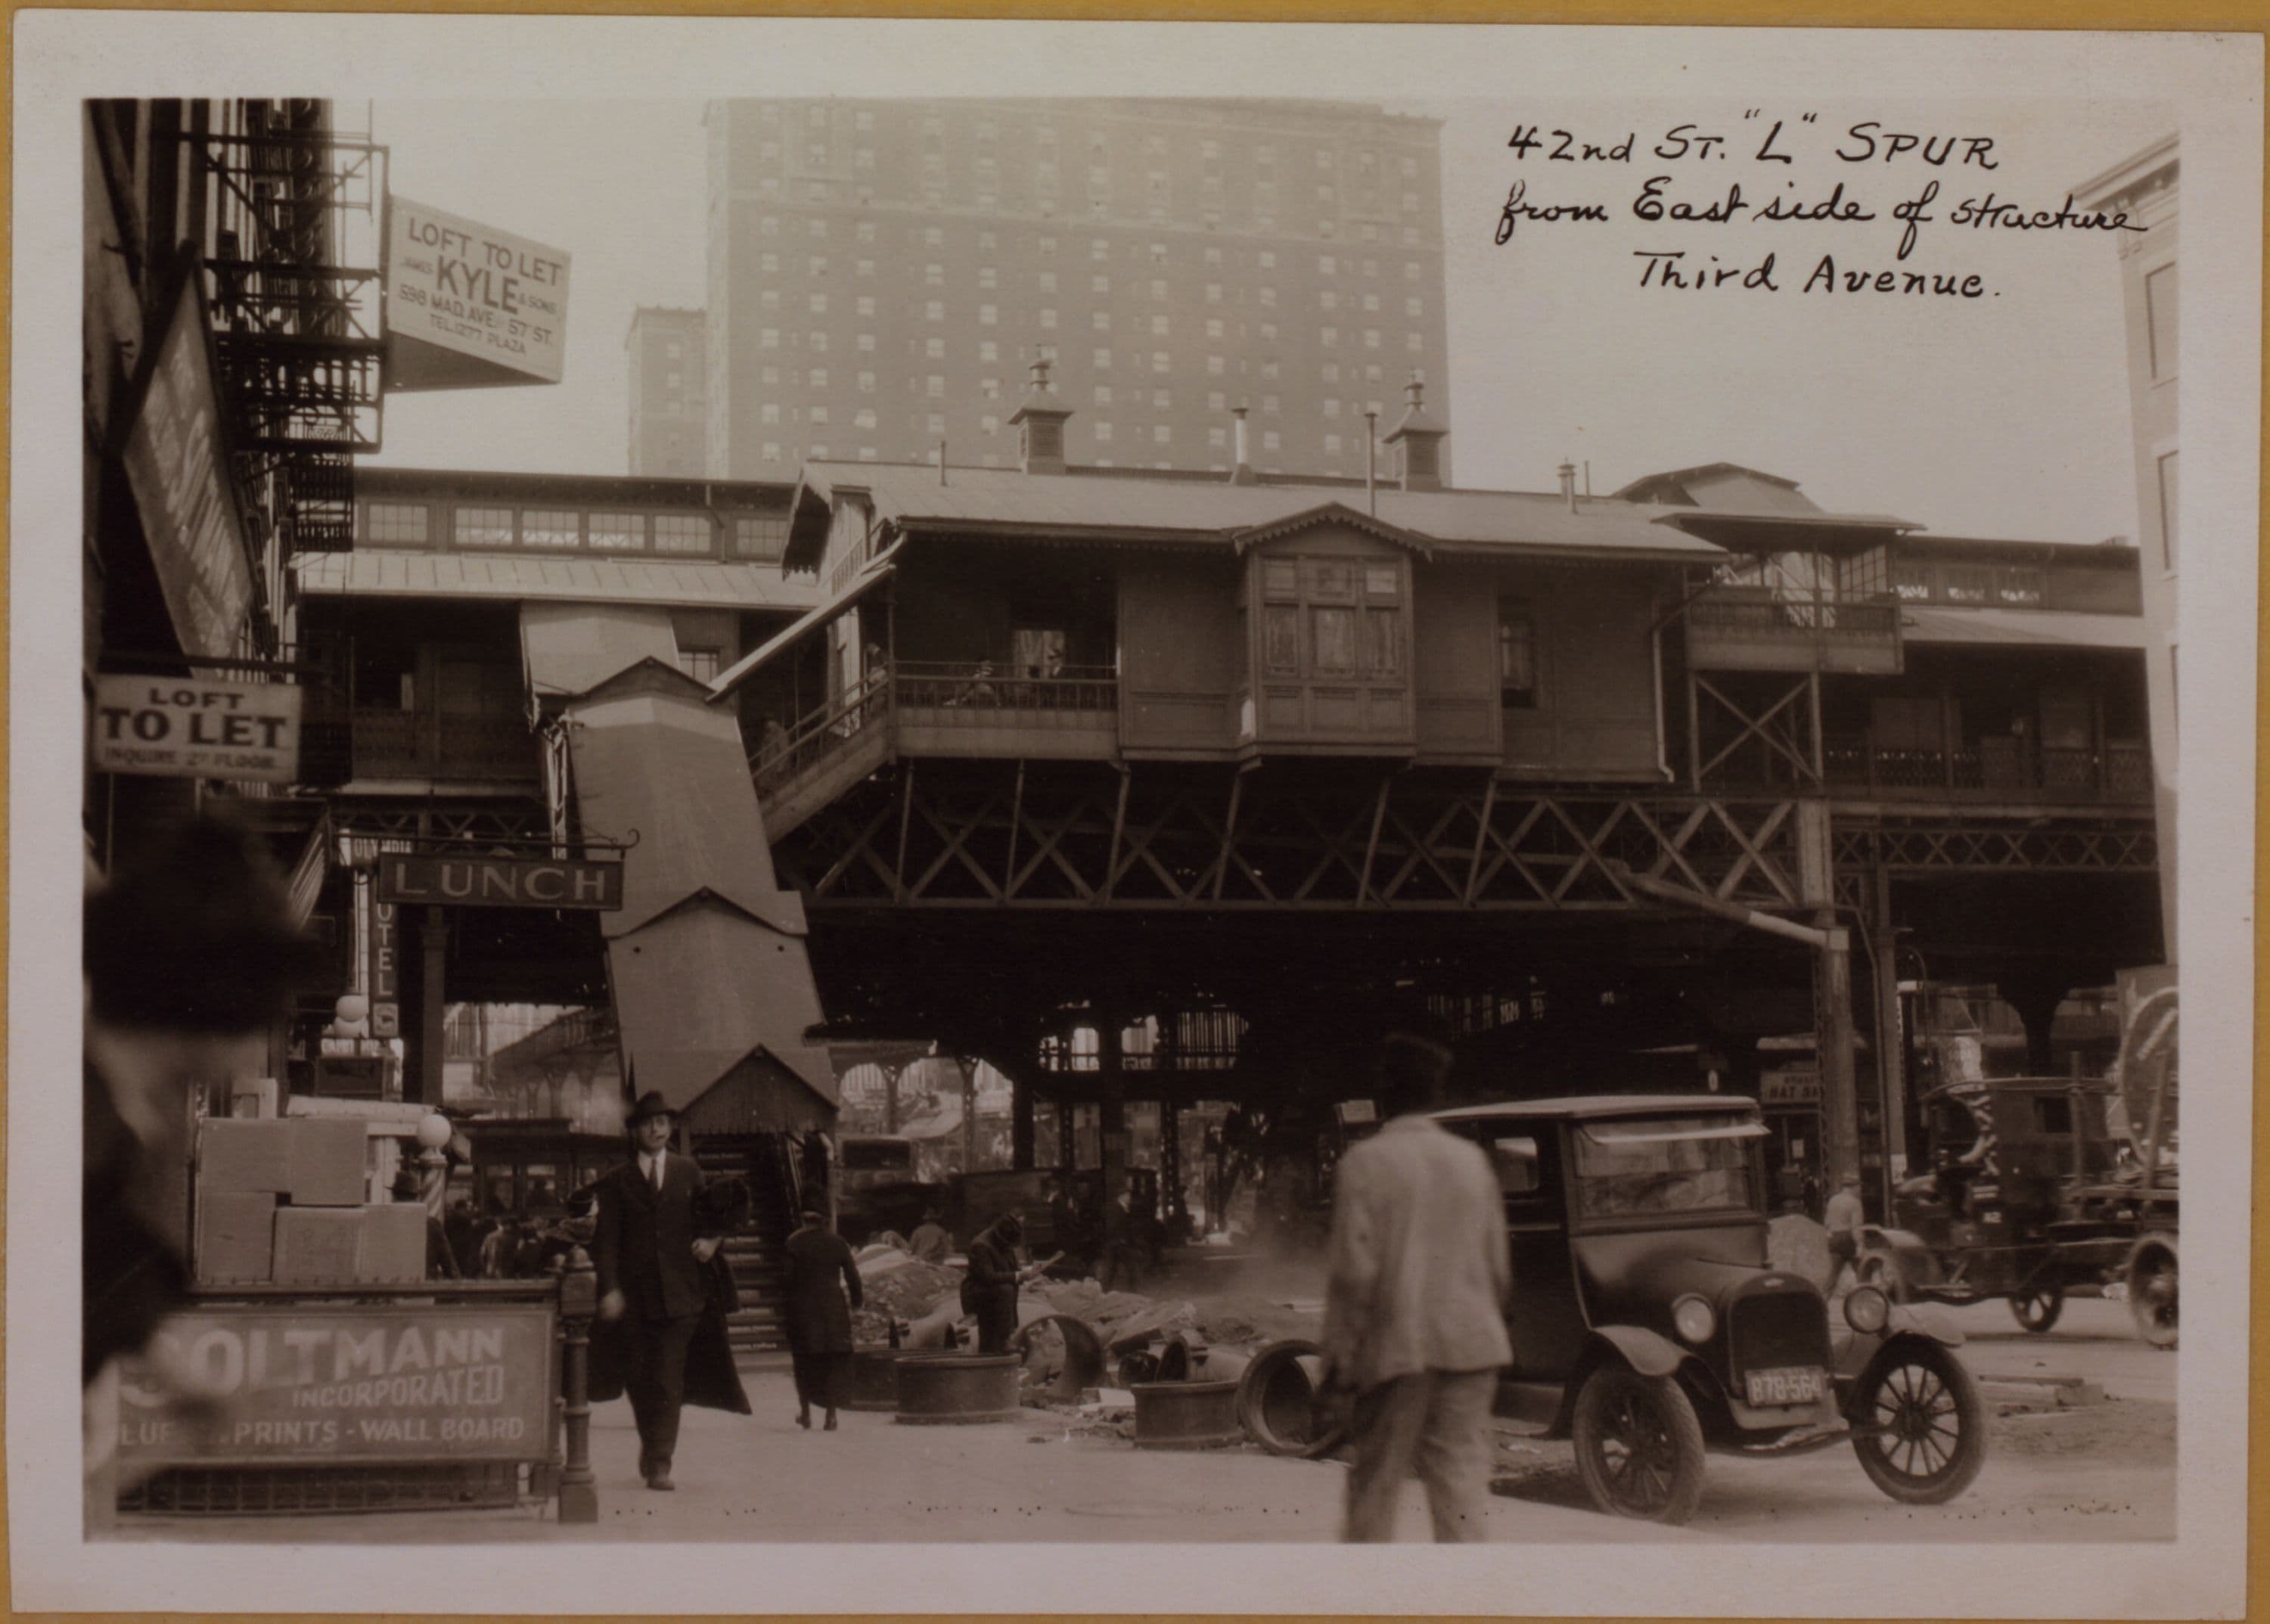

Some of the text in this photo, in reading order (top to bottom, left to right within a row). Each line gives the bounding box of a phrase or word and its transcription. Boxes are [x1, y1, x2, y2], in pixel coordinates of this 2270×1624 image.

[1508, 125, 1635, 163] 42nd
[1835, 122, 1998, 170] SPUR
[1495, 175, 2149, 261] from East side of structure
[408, 218, 564, 286] LOFT TO LET
[1633, 251, 1778, 292] Third
[436, 255, 519, 315] KYLE
[148, 688, 245, 710] LOFT
[101, 707, 287, 748] TO LET
[395, 862, 605, 901] LUNCH
[292, 1364, 505, 1408] INCORPORATED
[234, 1420, 339, 1444] PRINTS
[359, 1418, 433, 1442] WALL
[441, 1417, 525, 1441] BOARD
